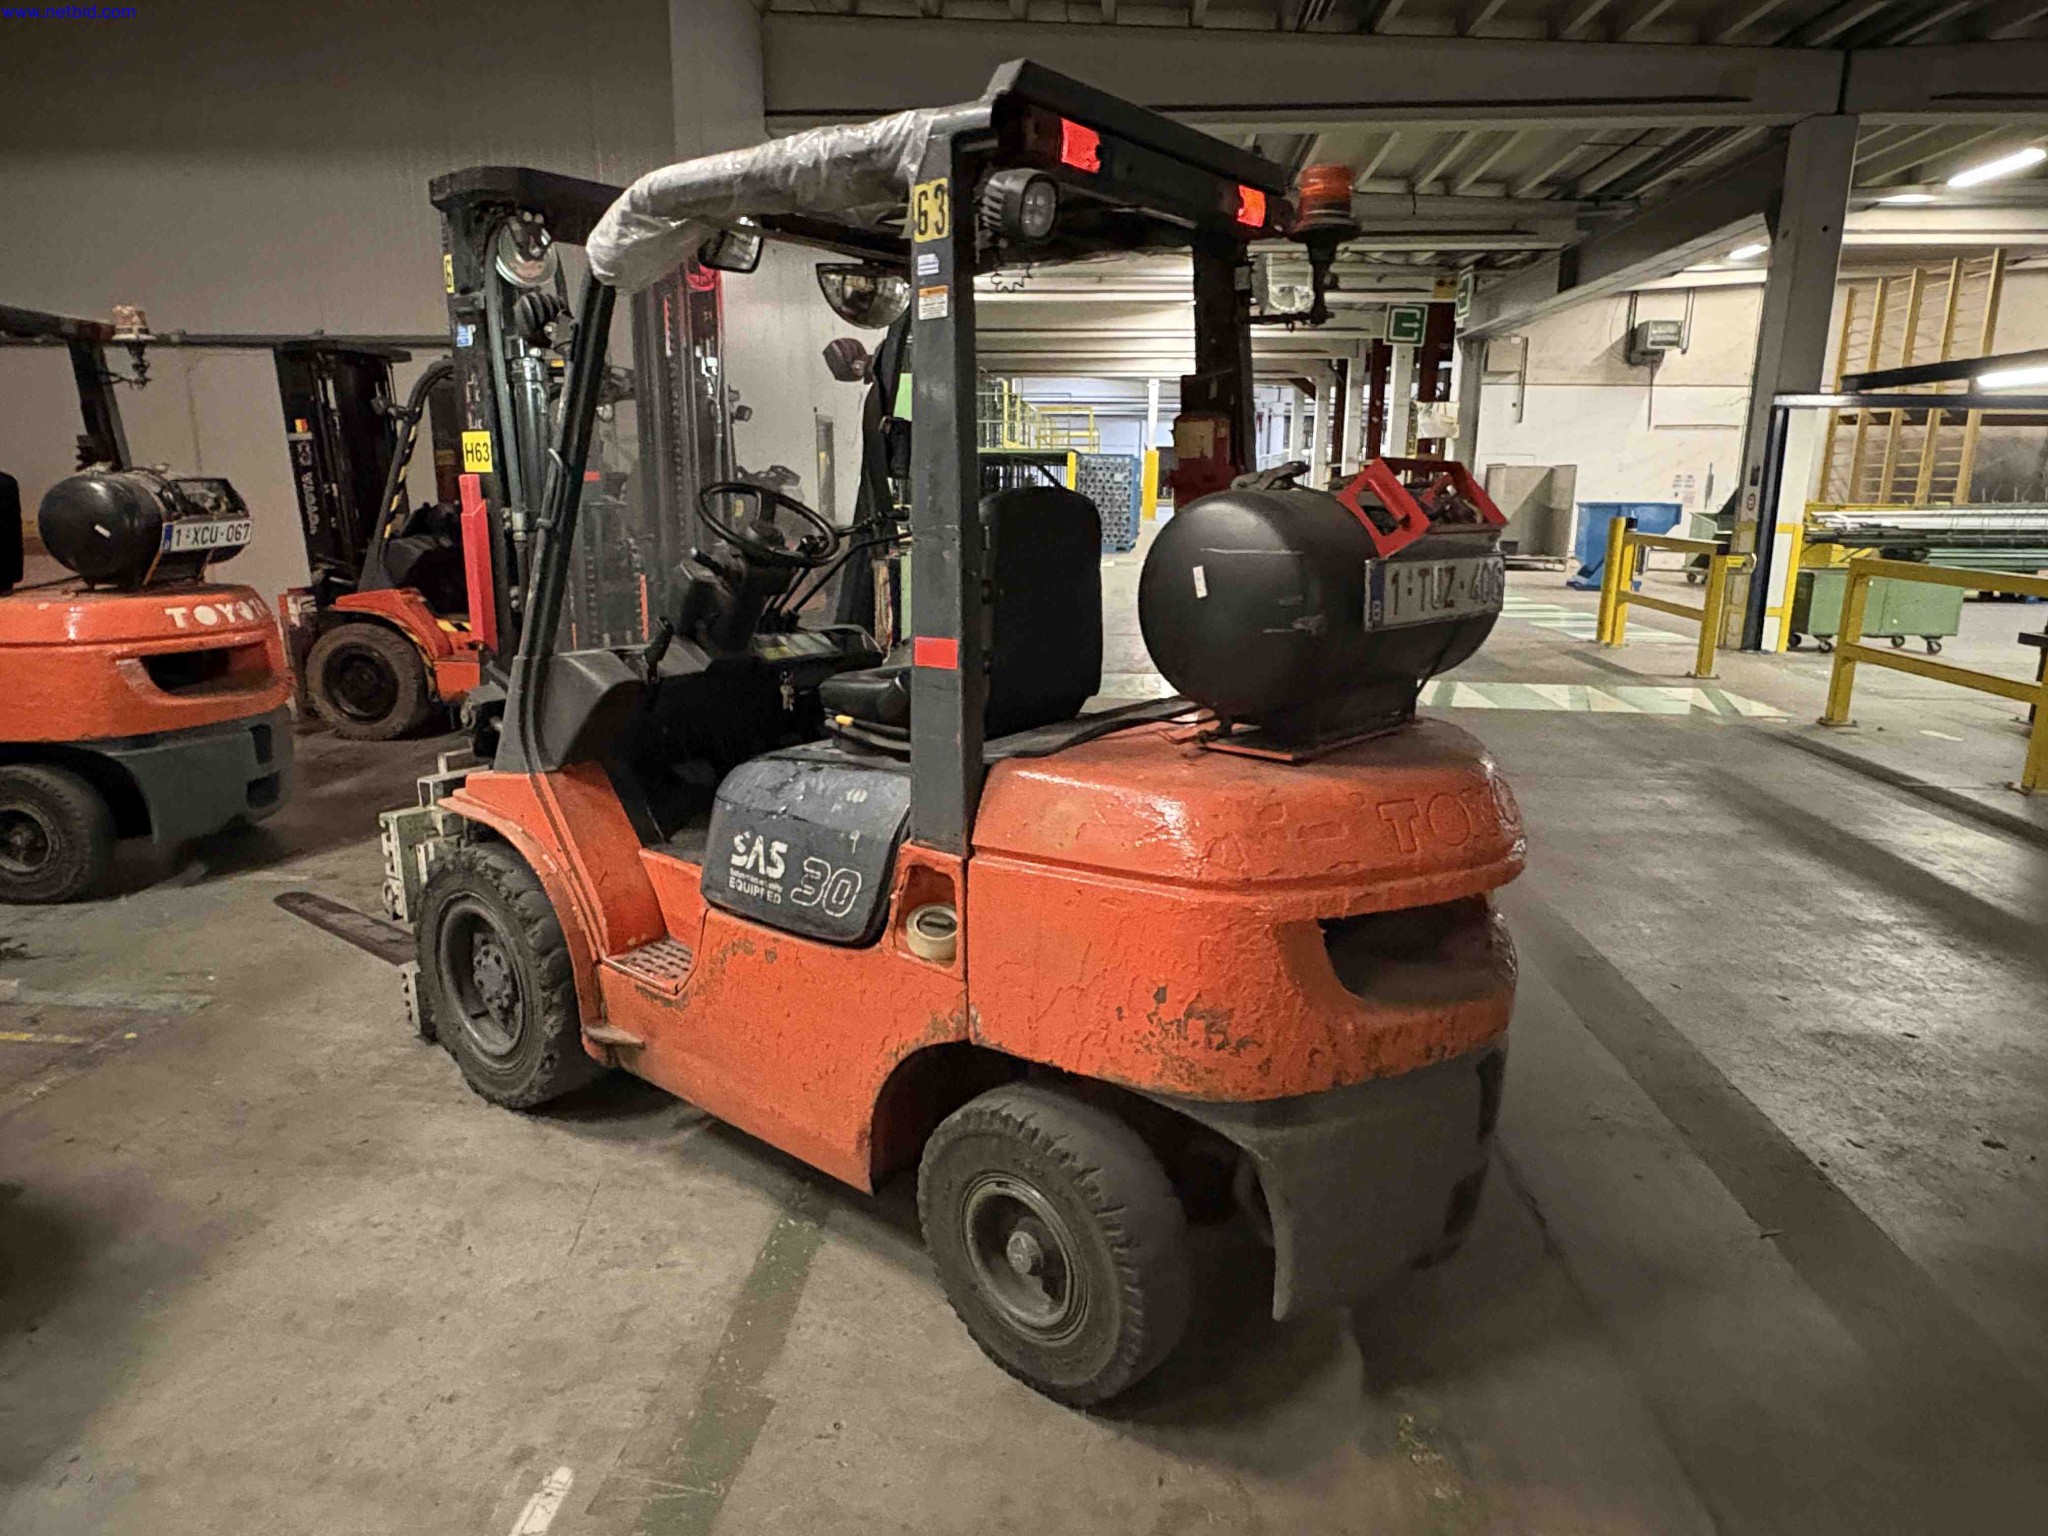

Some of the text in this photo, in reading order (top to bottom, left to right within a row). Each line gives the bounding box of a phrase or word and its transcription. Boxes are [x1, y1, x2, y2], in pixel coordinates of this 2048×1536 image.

[917, 184, 945, 236] 63
[464, 442, 491, 463] H63
[731, 832, 788, 879] SAS
[790, 856, 862, 917] 30
